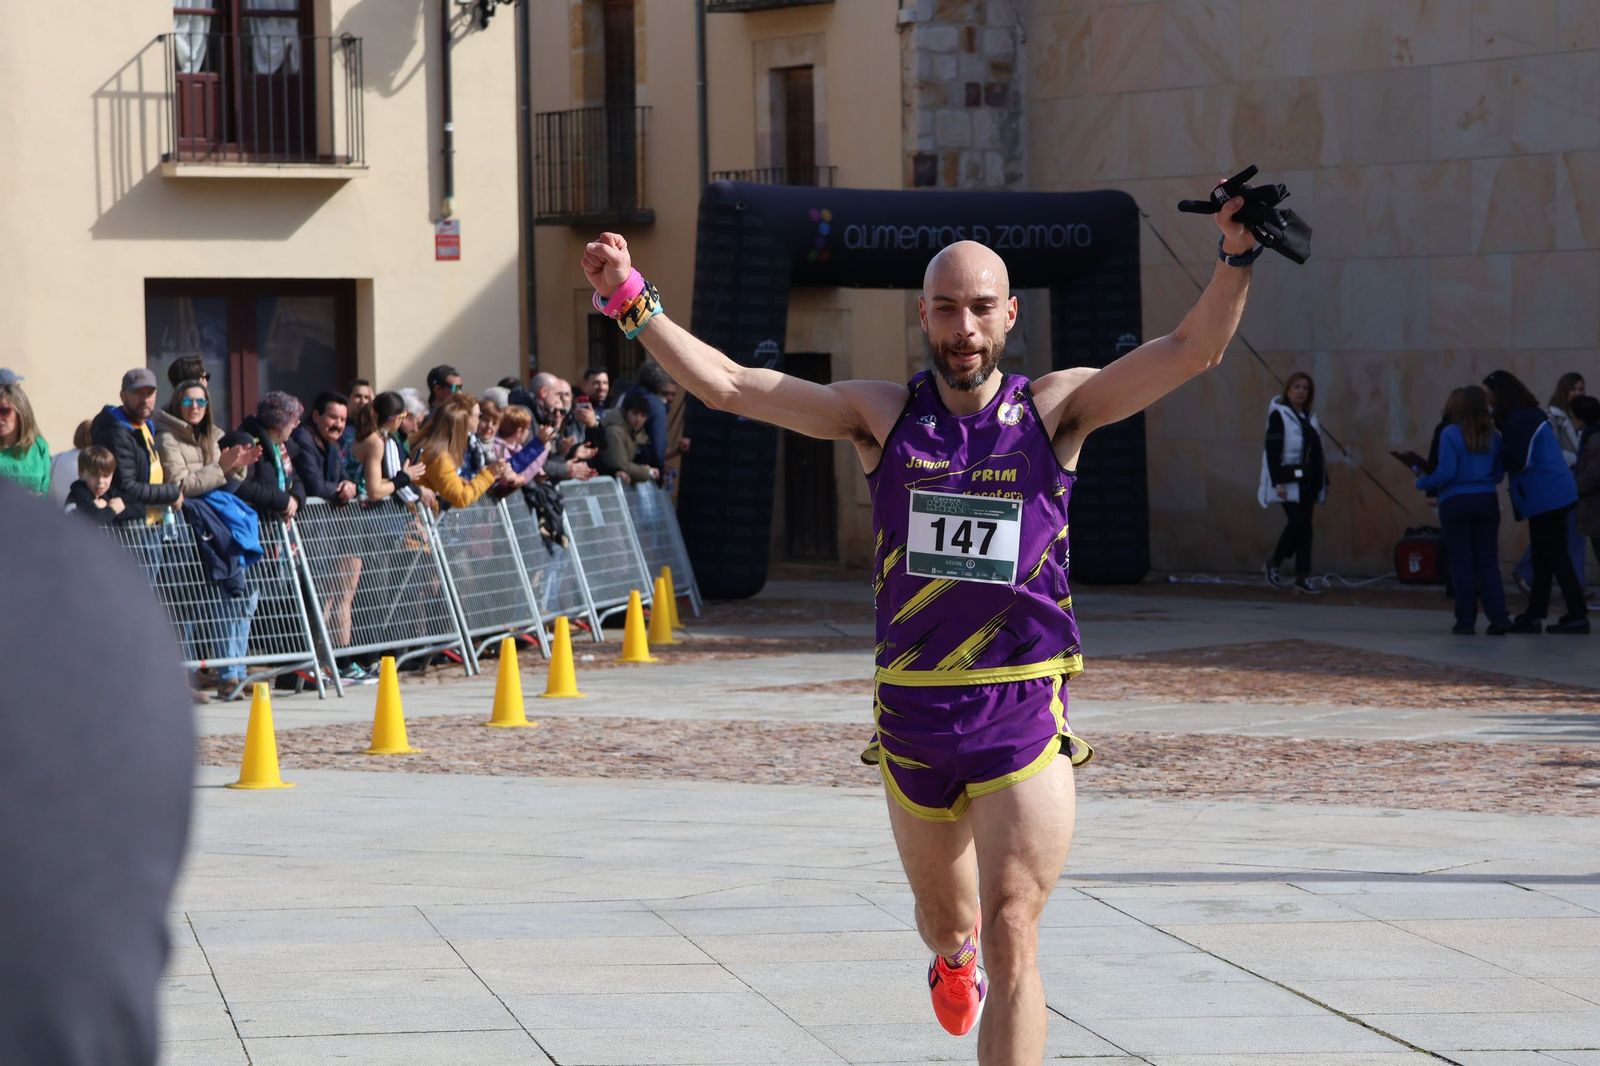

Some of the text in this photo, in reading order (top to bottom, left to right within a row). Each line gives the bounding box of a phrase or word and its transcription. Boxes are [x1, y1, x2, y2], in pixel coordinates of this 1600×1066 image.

[844, 224, 965, 249] alimentos
[997, 223, 1092, 248] zamora
[906, 455, 950, 470] Jamón
[972, 469, 1017, 483] PRIM
[930, 517, 998, 556] 147
